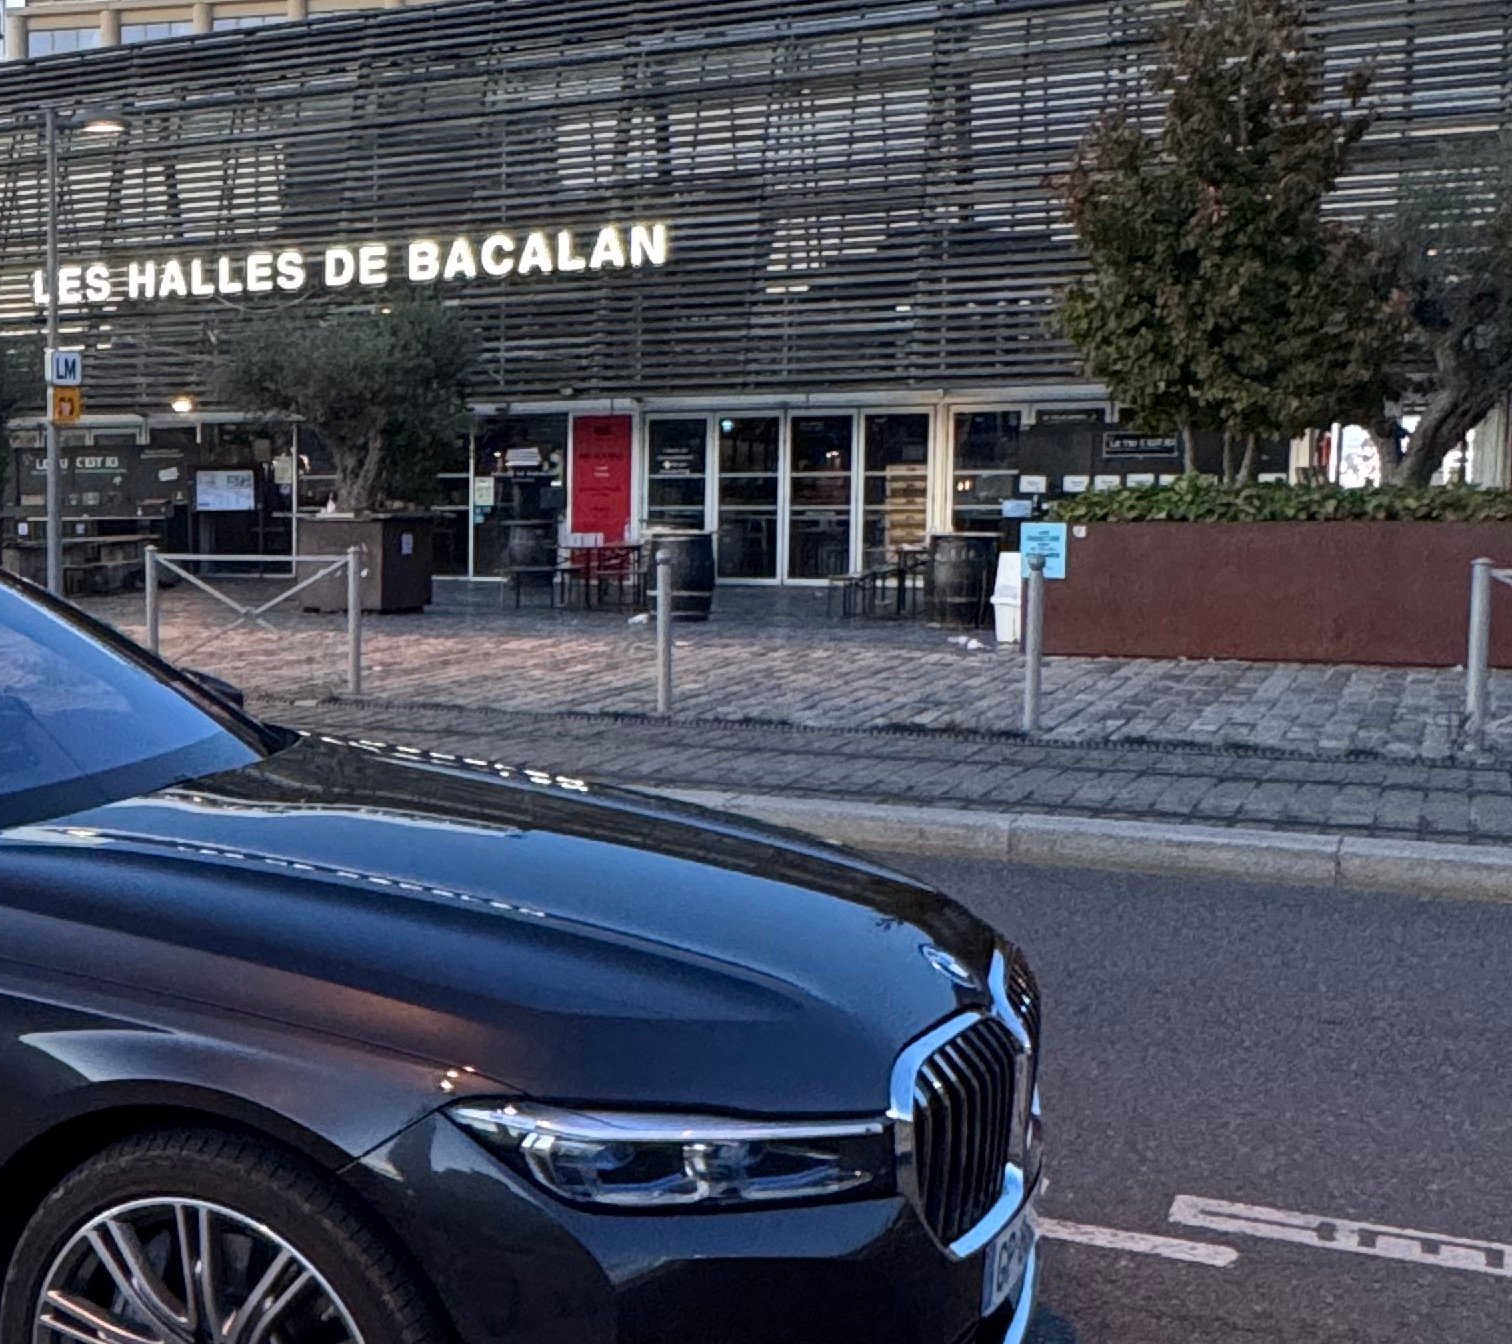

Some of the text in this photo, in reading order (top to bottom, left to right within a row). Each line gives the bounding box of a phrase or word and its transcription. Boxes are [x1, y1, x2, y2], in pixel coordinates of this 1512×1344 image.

[33, 224, 668, 305] LES HALLES DE BACALAN
[56, 357, 76, 381] LM
